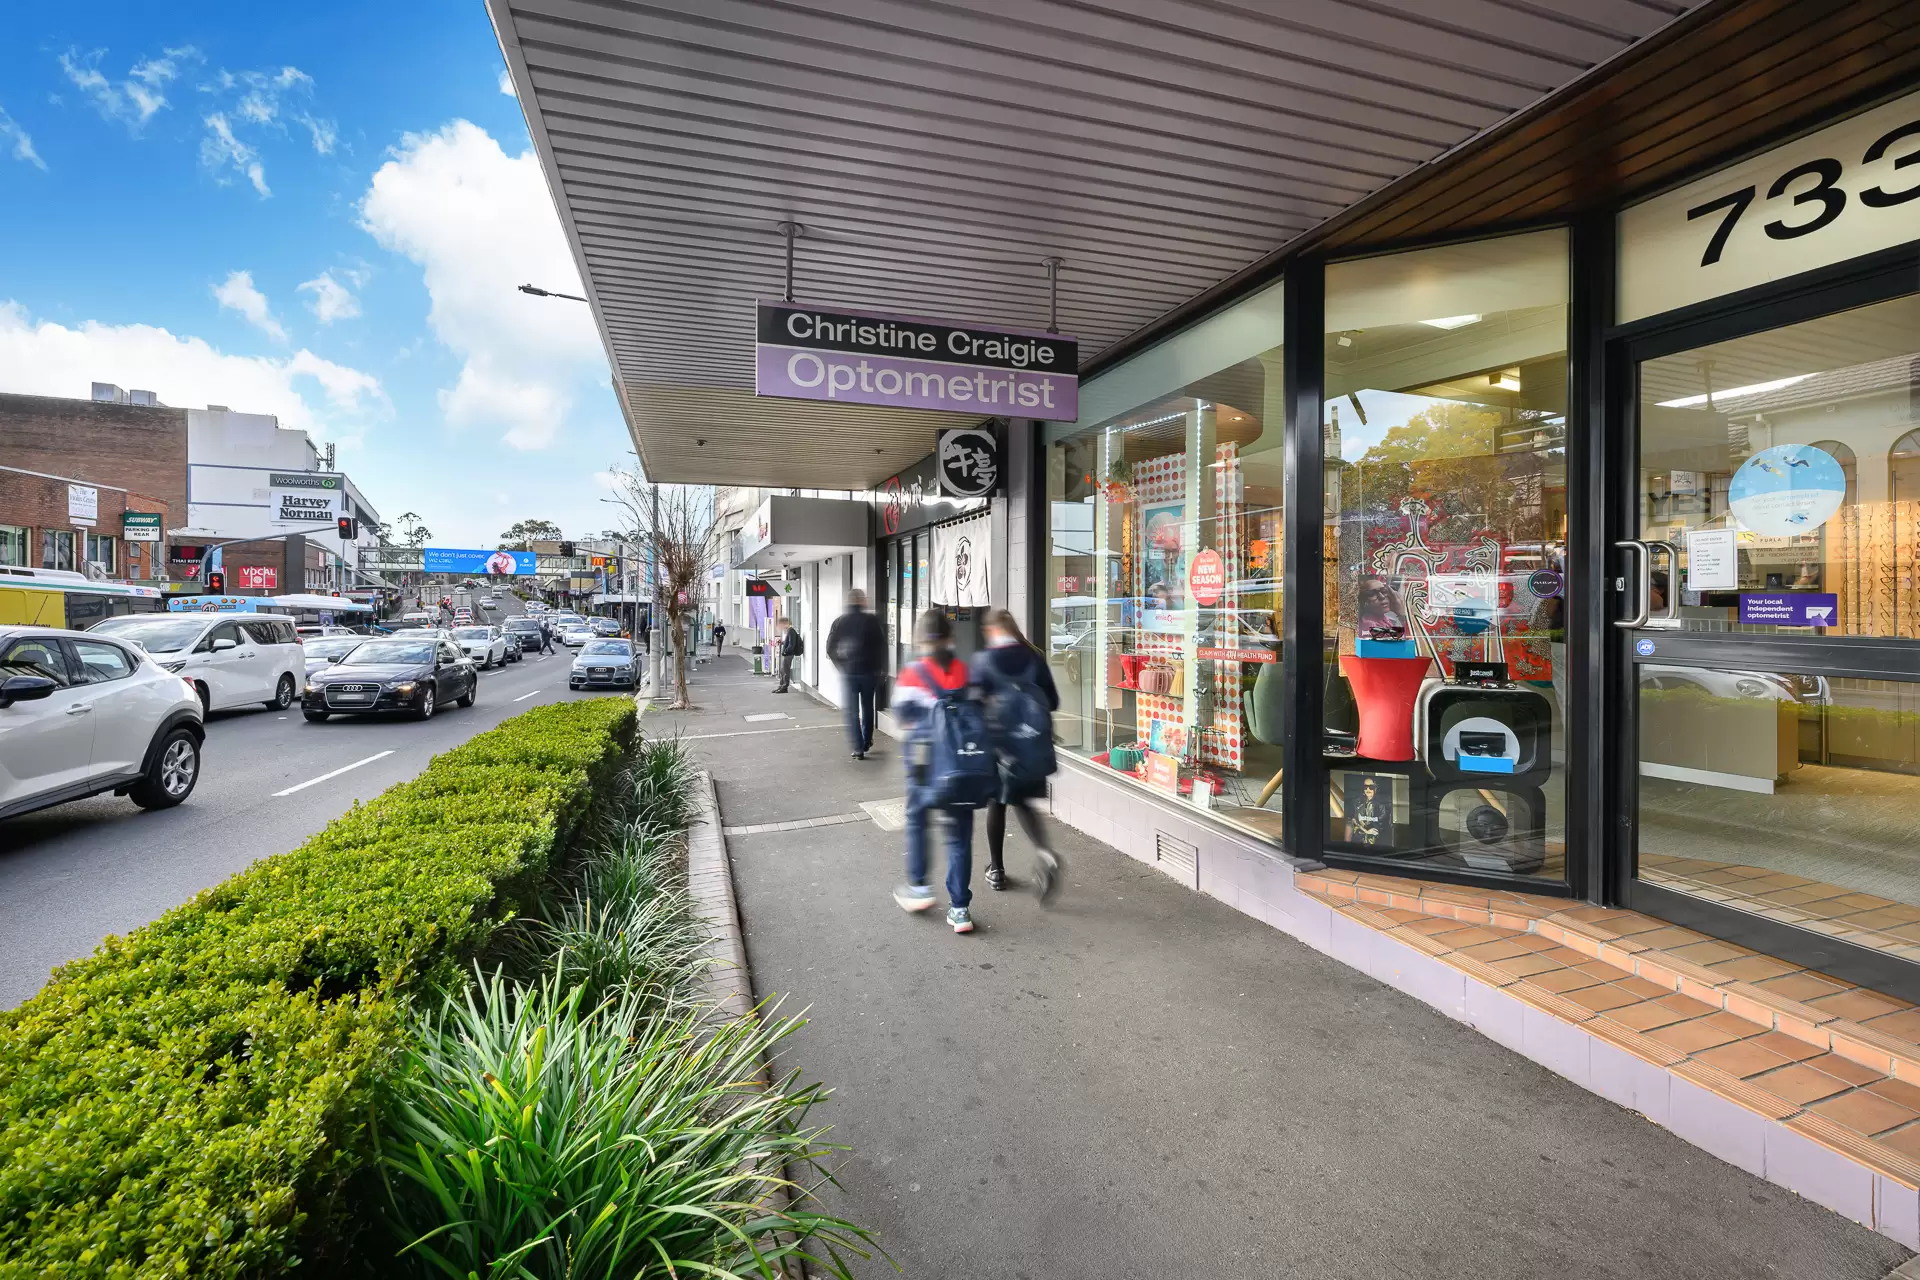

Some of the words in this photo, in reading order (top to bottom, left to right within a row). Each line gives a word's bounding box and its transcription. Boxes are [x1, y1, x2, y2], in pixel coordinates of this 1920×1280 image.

[1687, 119, 1920, 268] 733
[787, 312, 937, 351] Christine
[947, 330, 1055, 367] Craigie
[786, 352, 1055, 409] Optometrist
[275, 477, 320, 486] Woolworths
[282, 495, 331, 509] Harvey
[279, 507, 333, 520] Norman
[242, 567, 276, 576] VOCAL
[1197, 564, 1216, 574] NEW
[1191, 574, 1222, 585] SEASON
[1747, 612, 1790, 620] optometrist
[1257, 653, 1273, 661] FUND
